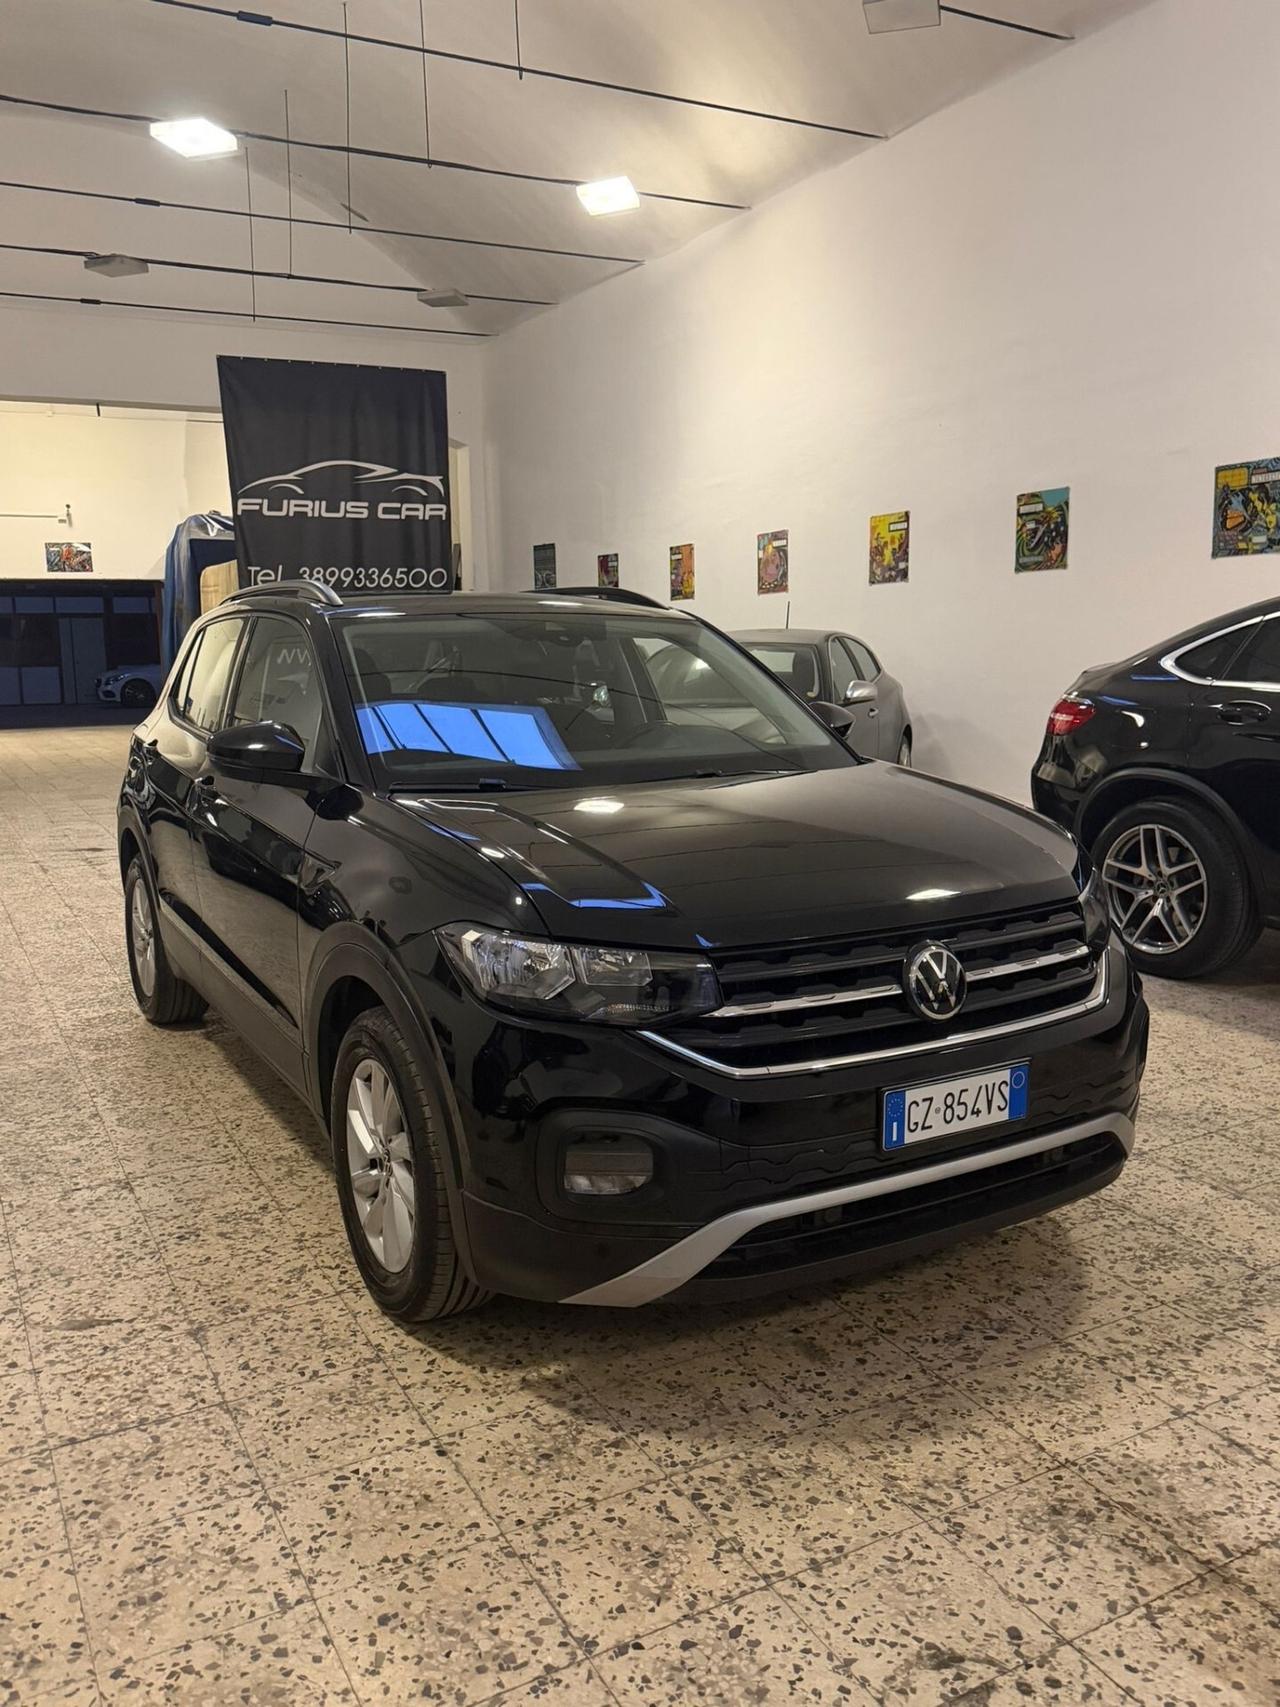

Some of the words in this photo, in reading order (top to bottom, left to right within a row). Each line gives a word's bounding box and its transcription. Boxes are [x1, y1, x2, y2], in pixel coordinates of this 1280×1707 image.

[237, 498, 369, 519] FURIUS
[377, 502, 447, 520] CAR
[299, 566, 448, 588] 3899336500
